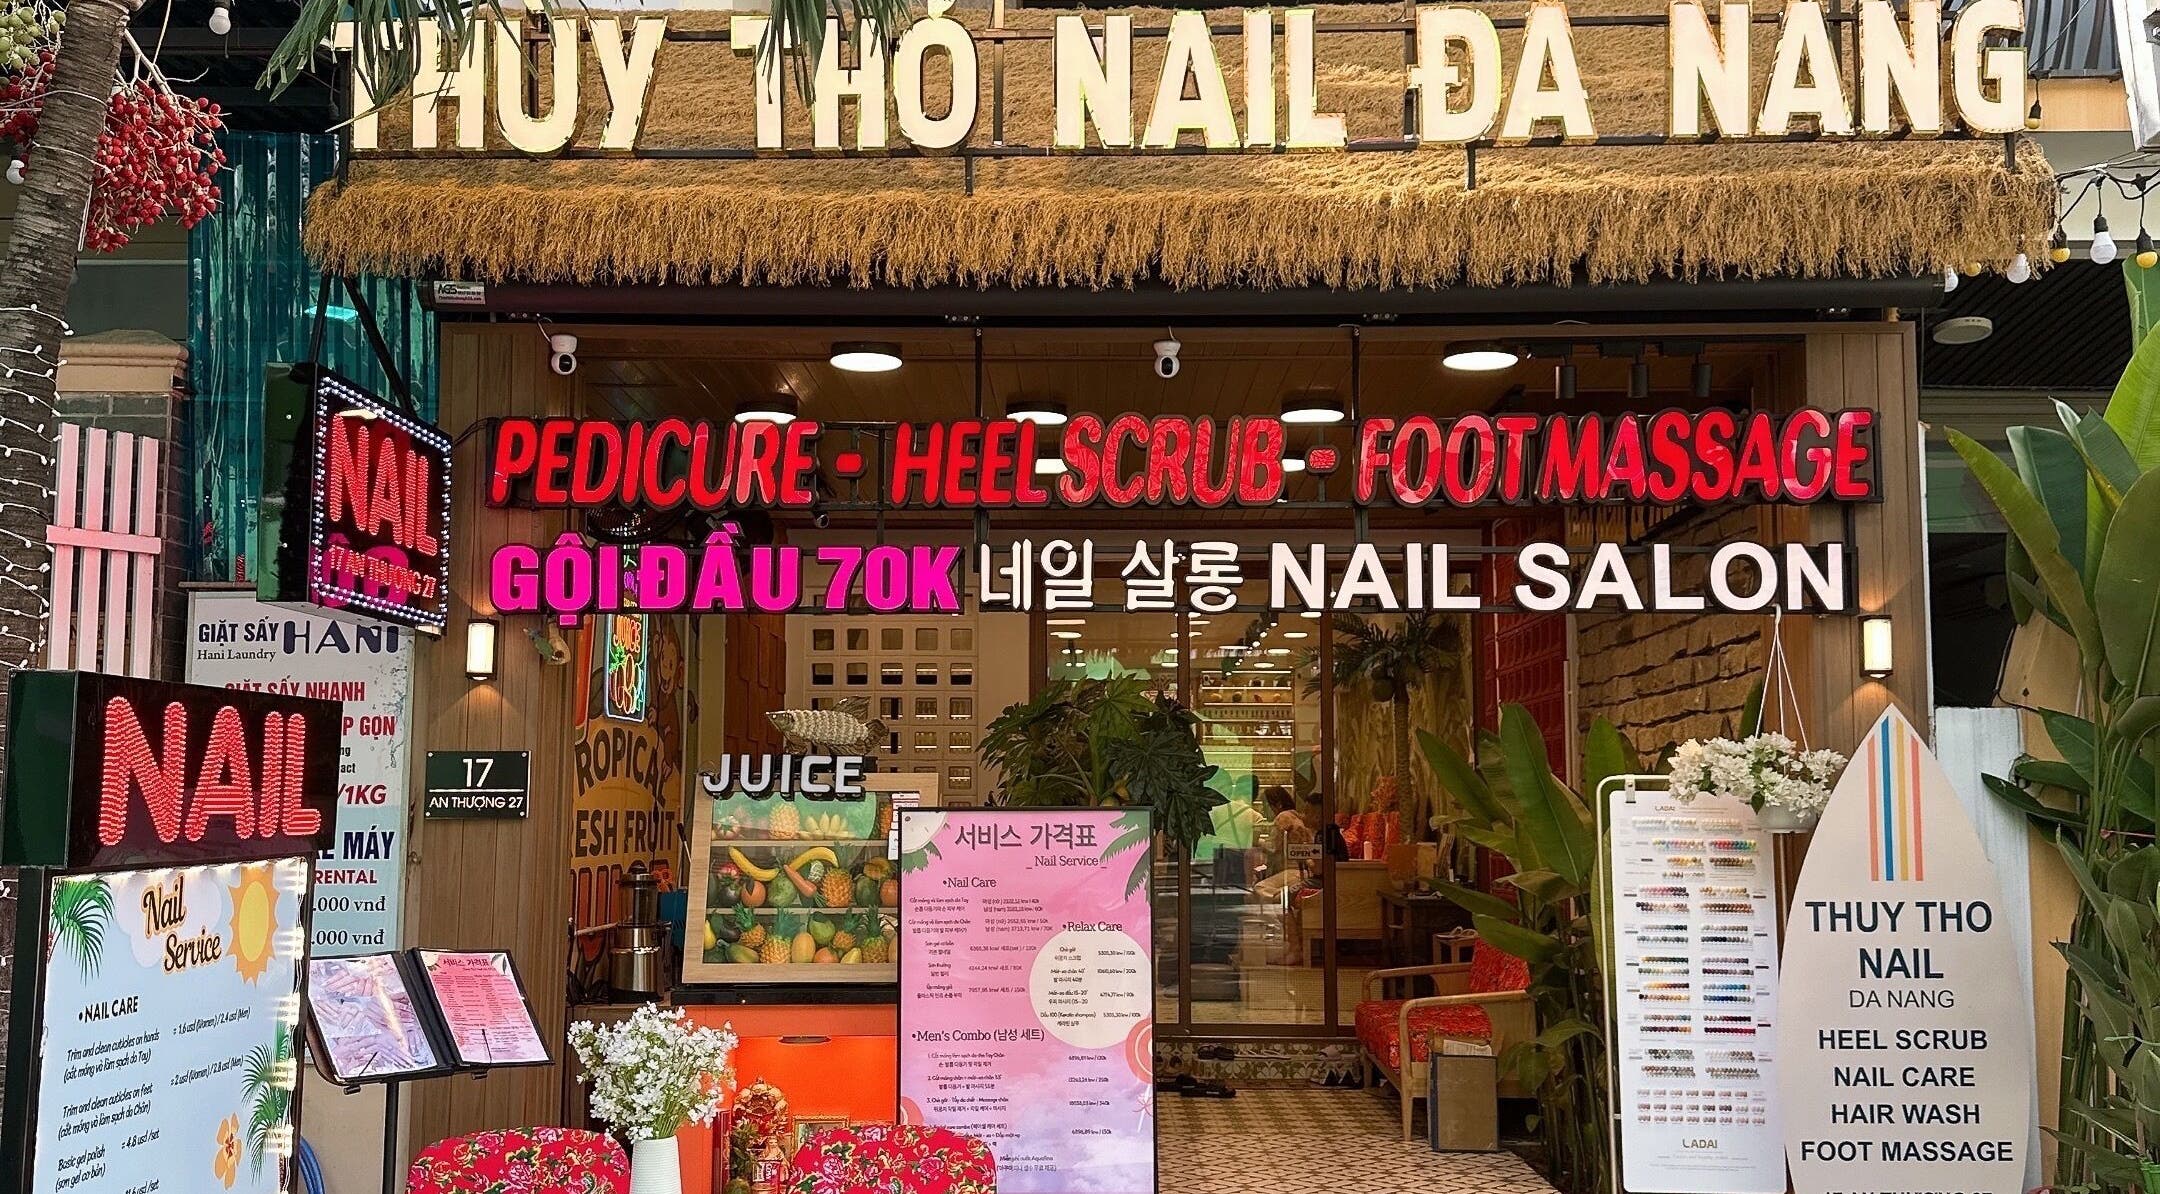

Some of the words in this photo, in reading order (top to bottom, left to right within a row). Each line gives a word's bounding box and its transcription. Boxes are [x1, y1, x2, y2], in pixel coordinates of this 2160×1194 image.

[1054, 9, 1348, 149] NAIL
[491, 418, 820, 507] PEDICURE
[891, 419, 1048, 504] HEEL
[1059, 415, 1284, 506] SCRUB
[1354, 415, 1538, 504] FOOT
[1540, 409, 1872, 501] MASSAGE
[329, 412, 438, 557] NAIL
[491, 531, 619, 626] GỘI
[638, 521, 800, 612] ĐẦU
[816, 545, 960, 611] 70K
[980, 538, 1094, 612] 네일
[1121, 538, 1245, 612] 살롱
[1271, 543, 1481, 609] NAIL
[1515, 541, 1844, 612] SALON
[198, 619, 238, 646] GIẶT
[243, 616, 279, 642] SẤY
[283, 619, 399, 655] HANI
[197, 649, 226, 660] Hani
[227, 648, 276, 662] Laundry
[306, 681, 365, 702] NHANH
[360, 715, 395, 740] GỌN
[98, 696, 322, 846] NAIL
[463, 758, 494, 788] 17
[703, 754, 863, 794] JUICE
[429, 796, 449, 808] AN
[508, 796, 524, 809] 27
[342, 825, 395, 860] MÁY
[623, 810, 675, 854] FRUIT
[954, 823, 1023, 850] 서비스
[1029, 823, 1098, 850] 가격표
[1034, 855, 1057, 867] Nail
[1059, 855, 1099, 867] Service
[947, 877, 970, 888] Nail
[971, 877, 997, 888] Care
[143, 875, 186, 935] Nail
[353, 895, 386, 912] vnđ
[1805, 901, 1905, 933] THUY
[1915, 900, 1993, 933] THO
[352, 929, 385, 945] vnđ
[1067, 921, 1096, 933] Relax
[1097, 921, 1123, 933] Care
[164, 928, 222, 972] Service
[1859, 948, 1944, 979] NAIL
[84, 1000, 110, 1023] NAIL
[111, 995, 139, 1017] CARE
[1850, 990, 1881, 1008] DA
[1888, 989, 1955, 1008] NANG
[67, 1047, 82, 1062] Trim
[82, 1042, 95, 1058] and
[95, 1041, 112, 1056] clean
[112, 1034, 136, 1052] cuticles
[136, 1036, 143, 1046] on
[143, 1027, 160, 1043] hands
[917, 1030, 950, 1042] Men's
[952, 1029, 992, 1042] Combo
[993, 1028, 1018, 1042] (남성
[1020, 1028, 1045, 1042] 세트)
[1818, 1029, 1888, 1050] HEEL
[1895, 1029, 1988, 1051] SCRUB
[1833, 1067, 1894, 1087] NAIL
[1902, 1066, 1976, 1087] CARE
[63, 1104, 78, 1119] Trim
[78, 1097, 91, 1113] and
[91, 1096, 108, 1111] clean
[108, 1088, 132, 1105] cuticles
[132, 1089, 140, 1098] on
[140, 1083, 153, 1098] feet
[1831, 1104, 1895, 1124] HAIR
[1902, 1104, 1981, 1124] WASH
[58, 1155, 77, 1172] Basic
[76, 1149, 87, 1169] gel
[87, 1144, 106, 1165] polish
[1682, 1139, 1718, 1149] LADAI
[1801, 1141, 1873, 1162] FOOT
[1882, 1141, 2014, 1162] MASSAGE
[70, 1169, 82, 1189] gel
